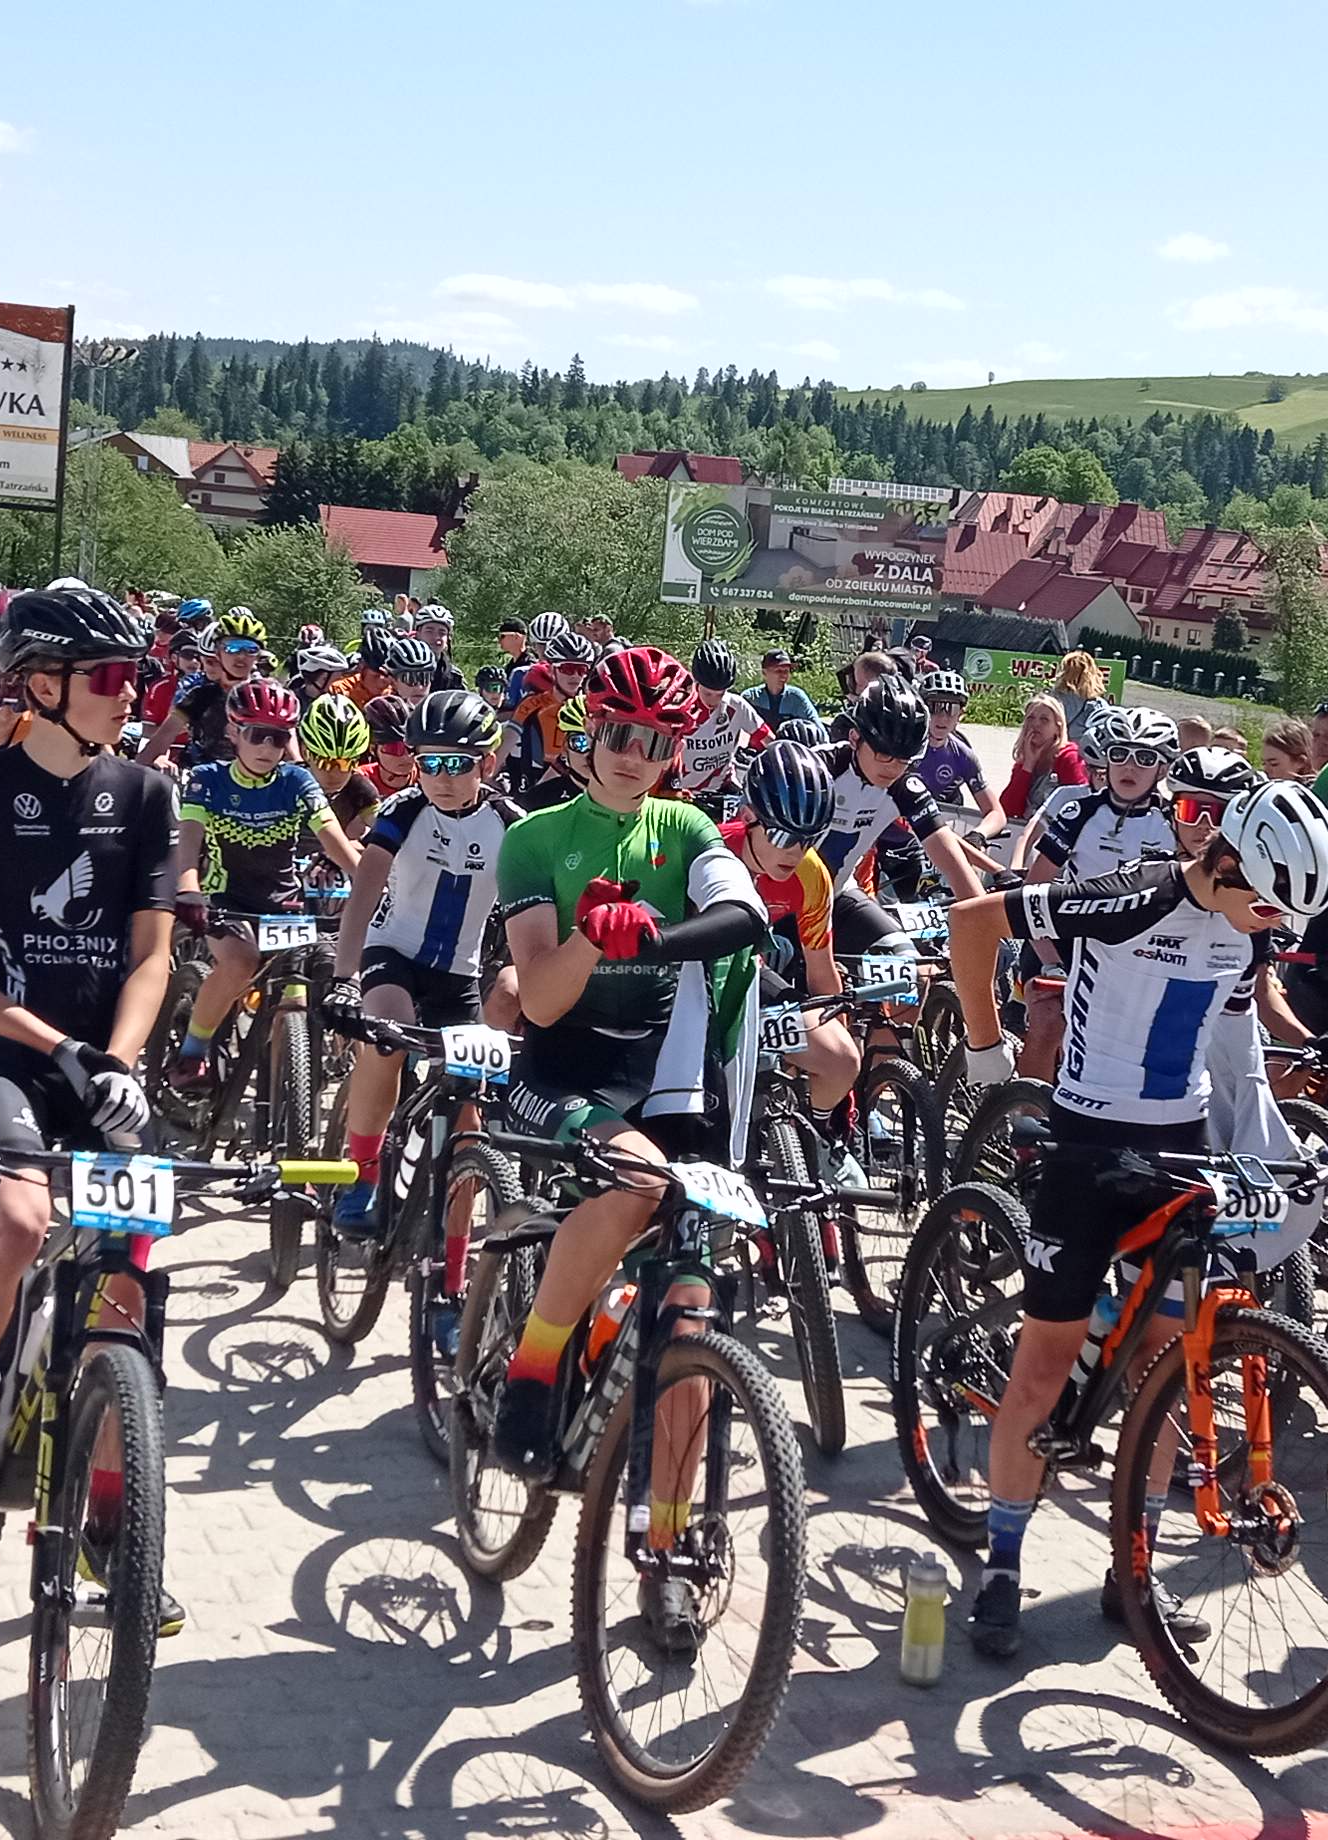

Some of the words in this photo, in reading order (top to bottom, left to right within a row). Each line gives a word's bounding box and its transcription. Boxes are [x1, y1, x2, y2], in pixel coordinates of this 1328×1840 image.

[3, 430, 48, 441] WELLNESS
[795, 497, 865, 510] KOMFORTOWE
[691, 536, 739, 548] WIERZBAMI
[697, 528, 717, 537] DOM
[717, 529, 734, 538] POD
[864, 550, 936, 565] WYPOCZYNEK
[874, 563, 885, 579] Z
[888, 566, 934, 583] DALA
[825, 578, 842, 589] OD
[845, 579, 890, 592] ZGIEŁKU
[890, 583, 933, 596] MIASTA
[22, 629, 74, 645] SCOTT
[686, 732, 735, 750] RESOVIA
[78, 826, 127, 835] SCOTT
[1057, 886, 1159, 915] GIANT
[266, 925, 311, 946] 515
[1132, 948, 1188, 968] eskom
[761, 1014, 801, 1050] 06
[508, 1080, 558, 1127] ZAWOJAK
[1057, 1086, 1113, 1112] GIANT
[86, 1167, 157, 1215] 501
